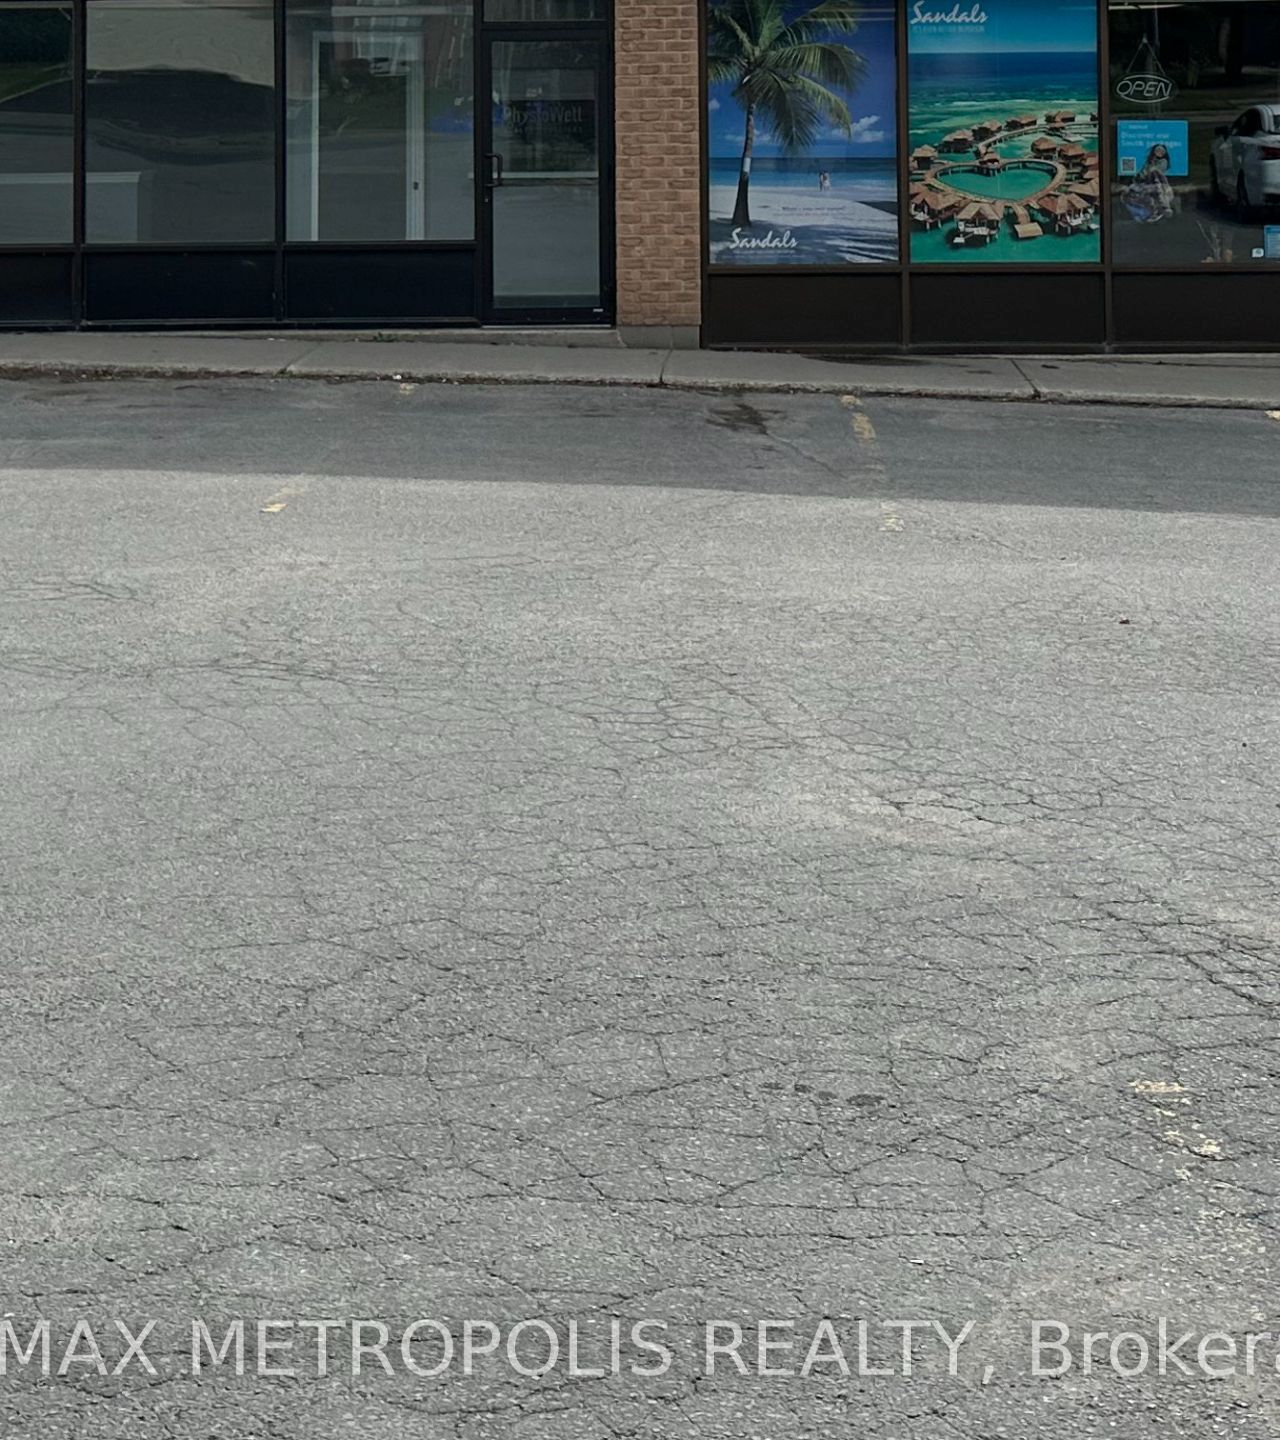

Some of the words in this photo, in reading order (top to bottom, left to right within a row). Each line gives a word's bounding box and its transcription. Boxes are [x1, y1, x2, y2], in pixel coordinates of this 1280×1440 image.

[910, 0, 989, 25] Sandals
[1116, 80, 1172, 97] OPEN
[729, 227, 798, 249] Sandals
